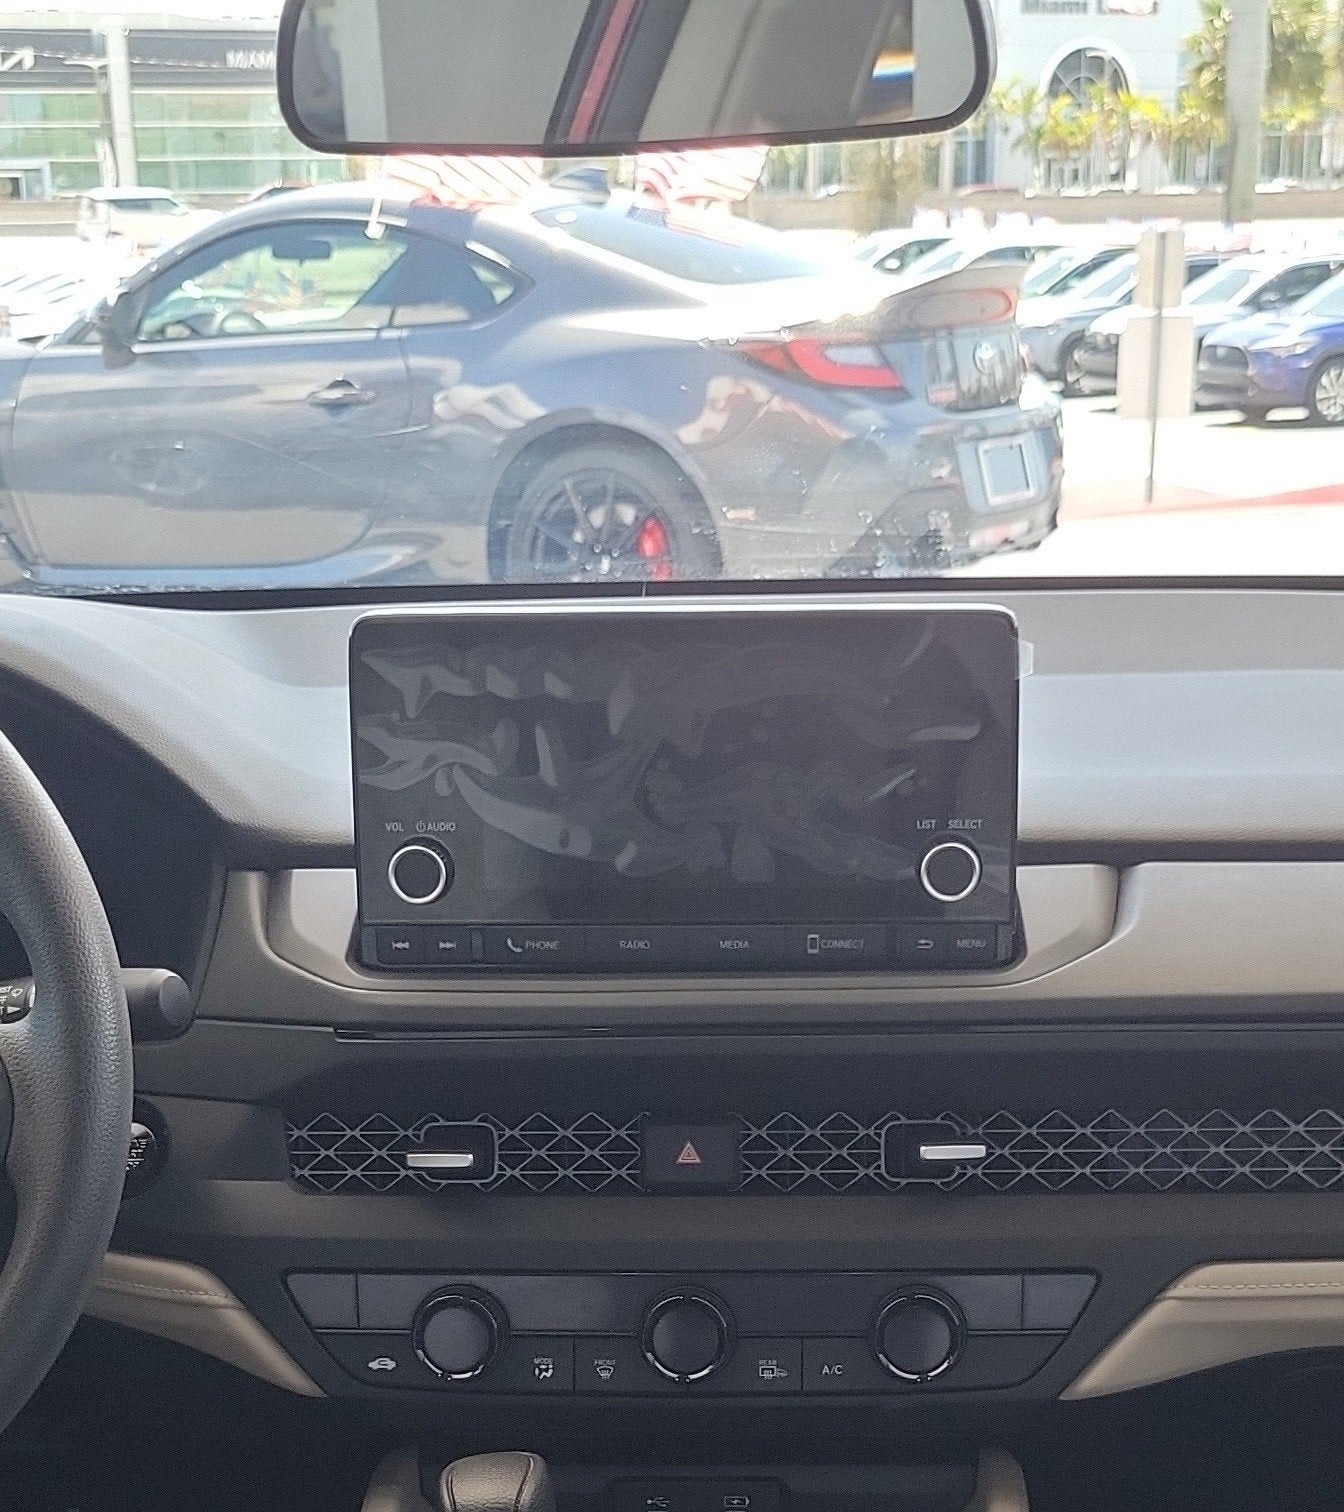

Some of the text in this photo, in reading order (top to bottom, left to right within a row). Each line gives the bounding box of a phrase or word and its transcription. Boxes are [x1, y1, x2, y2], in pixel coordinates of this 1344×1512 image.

[225, 49, 276, 71] MIAM
[385, 821, 404, 832] VOL
[427, 821, 457, 832] AUDIO
[916, 819, 937, 830] LIST
[948, 819, 983, 829] SELECT
[525, 940, 559, 950] PHONE
[619, 940, 651, 950] RADIO
[719, 940, 749, 949] MEDIA
[821, 939, 864, 949] CONNECT
[956, 939, 987, 948] MENU
[821, 1364, 844, 1375] A/C
